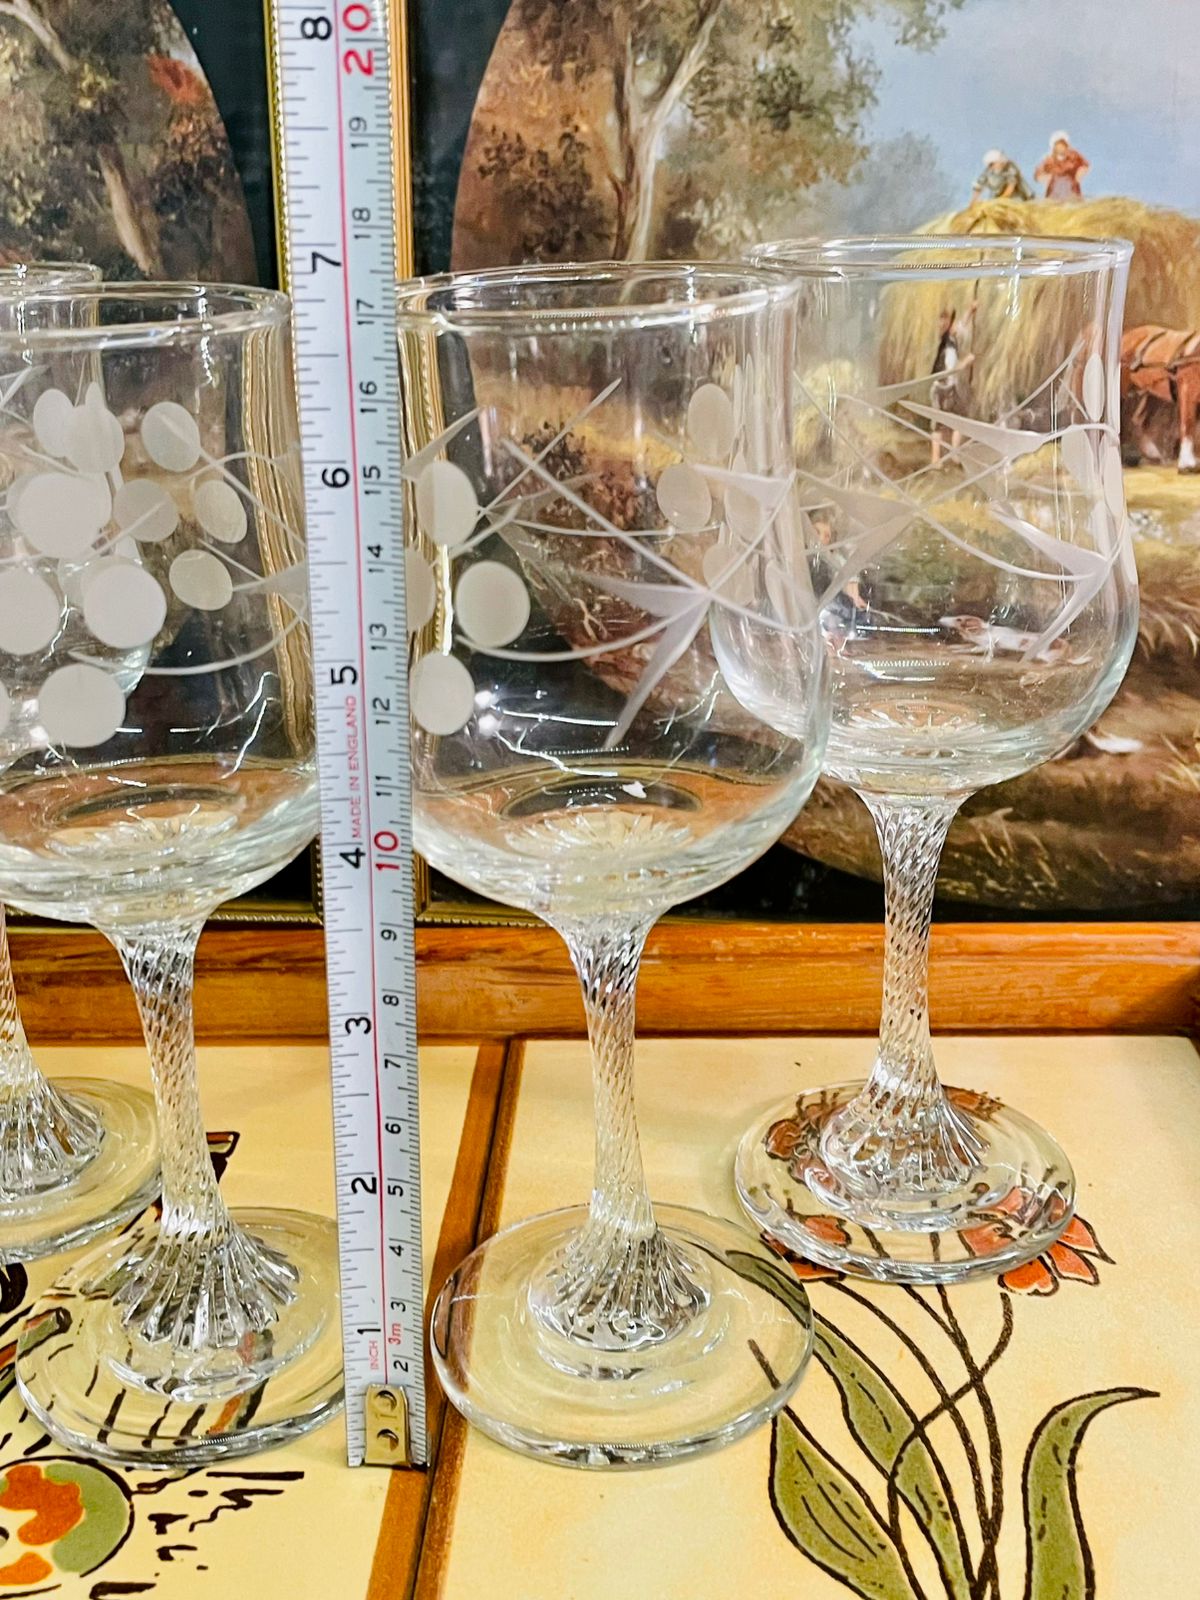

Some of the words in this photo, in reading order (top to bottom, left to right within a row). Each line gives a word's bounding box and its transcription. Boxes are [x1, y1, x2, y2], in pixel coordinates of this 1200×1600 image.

[301, 16, 332, 41] 8
[343, 3, 374, 76] 20
[349, 117, 369, 148] 19
[352, 207, 371, 240] 18
[312, 252, 342, 273] 7
[356, 299, 375, 326] 17
[359, 381, 378, 413] 16
[322, 467, 350, 489] 6
[363, 465, 381, 495] 15
[367, 544, 385, 573] 14
[369, 623, 388, 651] 13
[330, 665, 359, 686] 5
[373, 697, 391, 725] 12
[345, 695, 360, 771] ENGLAND
[349, 776, 361, 791] IN
[375, 775, 392, 797] 11
[351, 796, 362, 838] MADE
[339, 848, 366, 869] 4
[374, 831, 400, 872] 10
[380, 929, 397, 942] 9
[382, 994, 400, 1007] 8
[344, 1016, 372, 1035] 3
[384, 1059, 401, 1069] 7
[385, 1122, 401, 1135] 6
[351, 1176, 377, 1195] 2
[387, 1184, 404, 1197] 5
[389, 1244, 405, 1257] 4
[390, 1301, 406, 1313] 3
[357, 1328, 381, 1336] 1
[388, 1323, 402, 1345] 3m
[369, 1340, 380, 1371] INCH
[393, 1360, 409, 1373] 2
